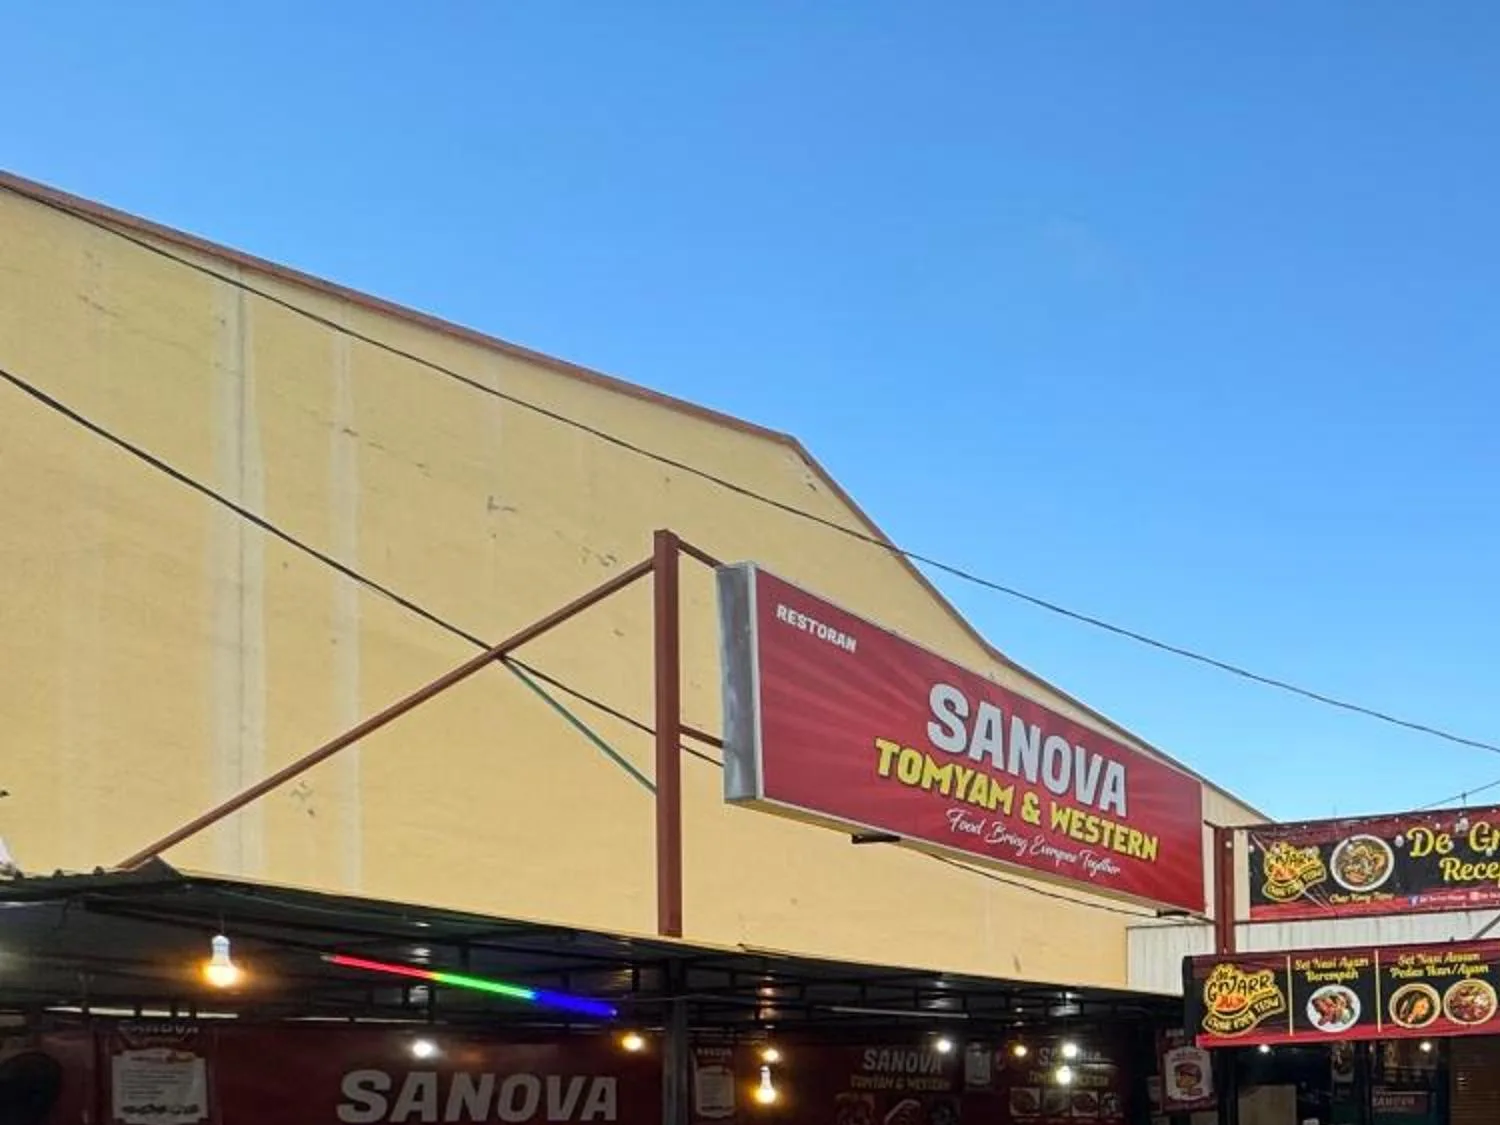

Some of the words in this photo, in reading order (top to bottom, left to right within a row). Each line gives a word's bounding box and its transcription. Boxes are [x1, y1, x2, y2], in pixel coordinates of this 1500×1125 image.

[776, 603, 857, 654] RESTORAN
[928, 683, 1127, 817] SANOVA
[875, 738, 1015, 816] TOMYAM
[1021, 792, 1042, 826] &
[1051, 801, 1159, 862] WESTERN
[945, 808, 987, 836] Food
[1406, 826, 1452, 857] De
[862, 1048, 942, 1074] SANOVA
[337, 1070, 618, 1124] SANOVA
